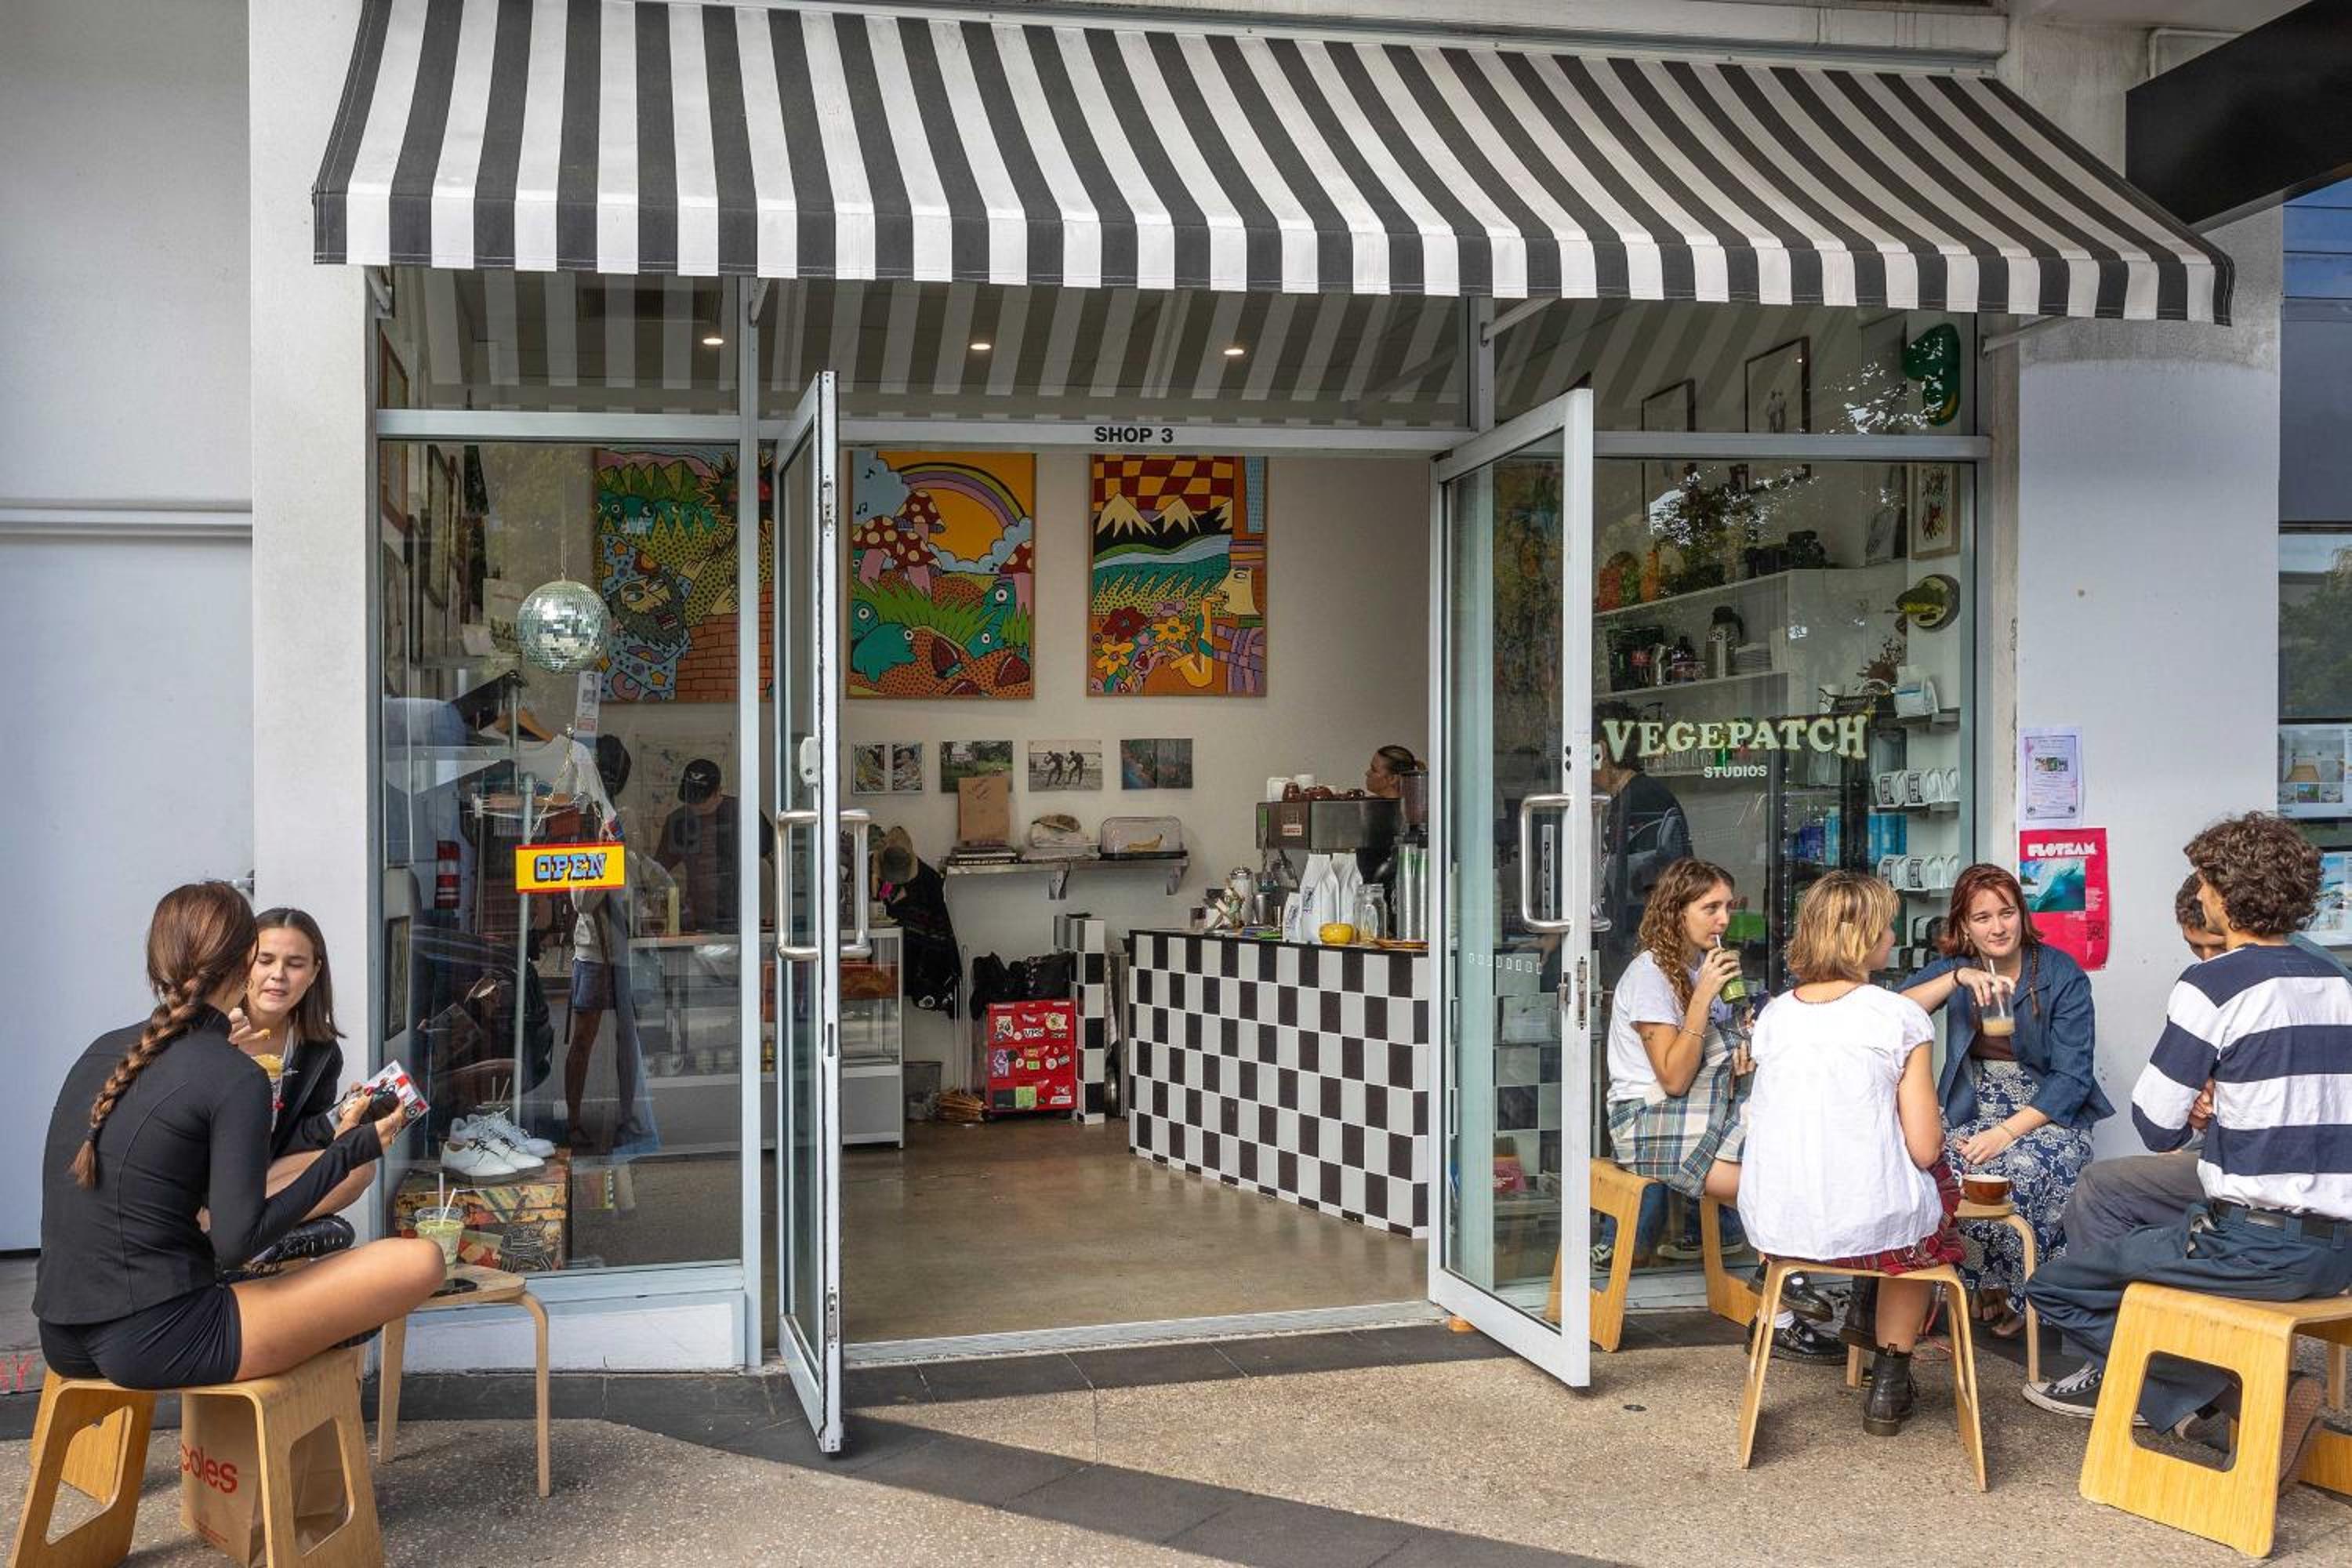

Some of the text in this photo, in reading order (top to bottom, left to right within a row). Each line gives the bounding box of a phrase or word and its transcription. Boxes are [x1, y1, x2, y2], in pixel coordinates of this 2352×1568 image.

[1094, 426, 1174, 444] SHOP 3
[1602, 713, 1868, 763] VEGEPATCH
[1703, 764, 1768, 779] STUDIOS
[533, 852, 608, 883] OPEN
